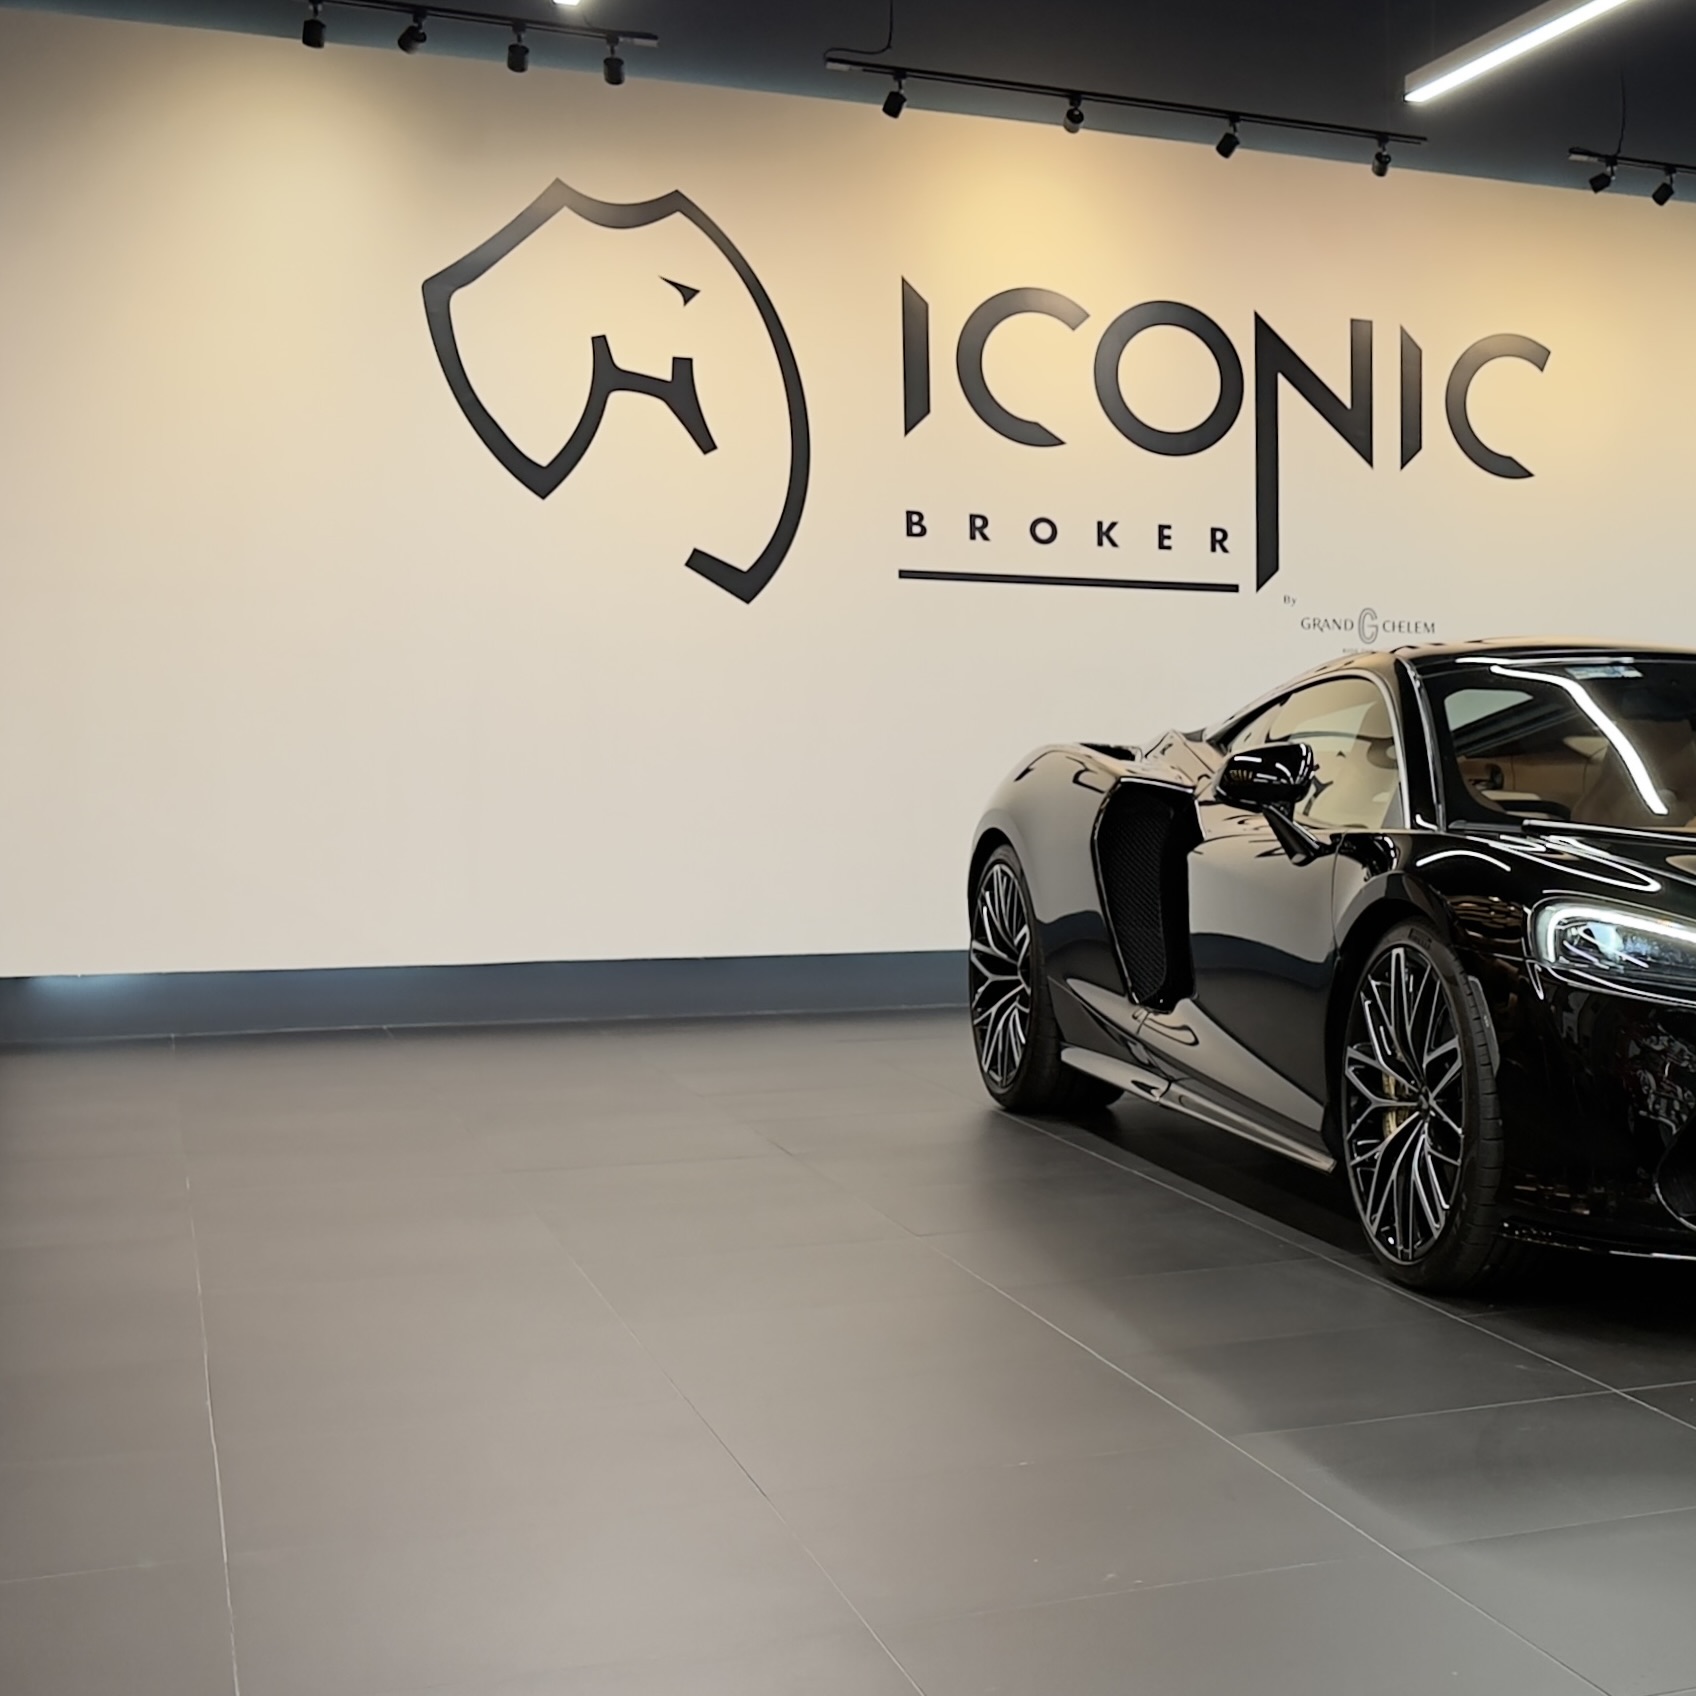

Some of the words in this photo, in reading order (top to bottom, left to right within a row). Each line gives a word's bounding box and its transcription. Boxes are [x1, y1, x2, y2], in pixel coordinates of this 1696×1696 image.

[901, 275, 1551, 592] ICONIC
[904, 510, 1230, 554] BROKER
[1283, 595, 1297, 607] By
[1300, 616, 1355, 633] GRAND
[1382, 619, 1436, 634] CHELEM
